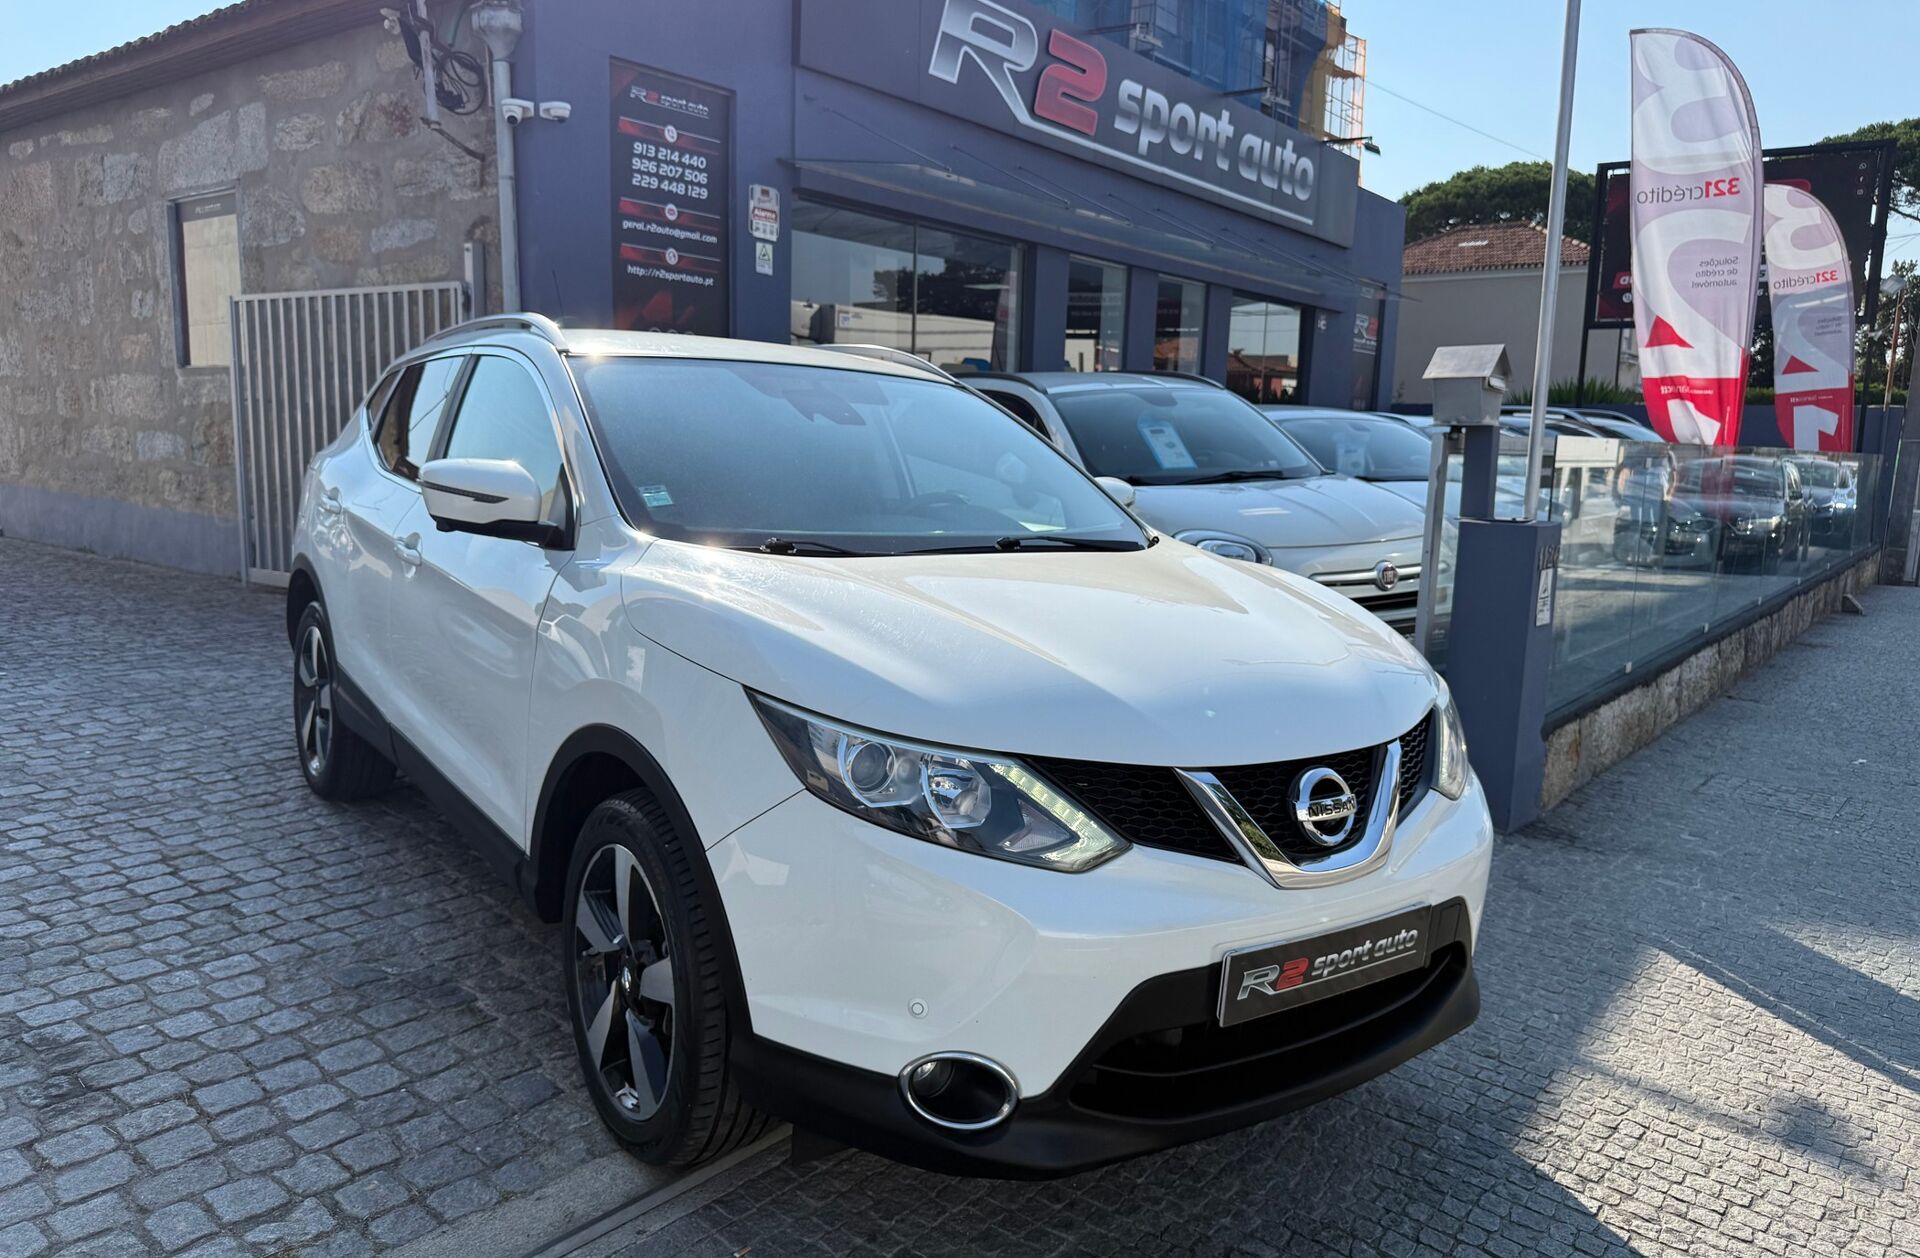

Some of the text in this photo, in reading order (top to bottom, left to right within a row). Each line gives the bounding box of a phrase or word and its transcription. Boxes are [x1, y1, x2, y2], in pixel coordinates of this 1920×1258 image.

[660, 95, 687, 109] sport
[688, 102, 710, 116] auto
[928, 0, 1314, 201] R2 sport auto
[633, 142, 707, 169] 913 214 440
[632, 157, 708, 185] 926 207 506
[632, 173, 708, 200] 229 448 129
[622, 220, 718, 243] geral.r2auto@gmail.com
[627, 264, 714, 287] http://r2sportauto.pt
[1307, 795, 1355, 817] NISSAN
[1237, 928, 1419, 1000] R2 sport auto
